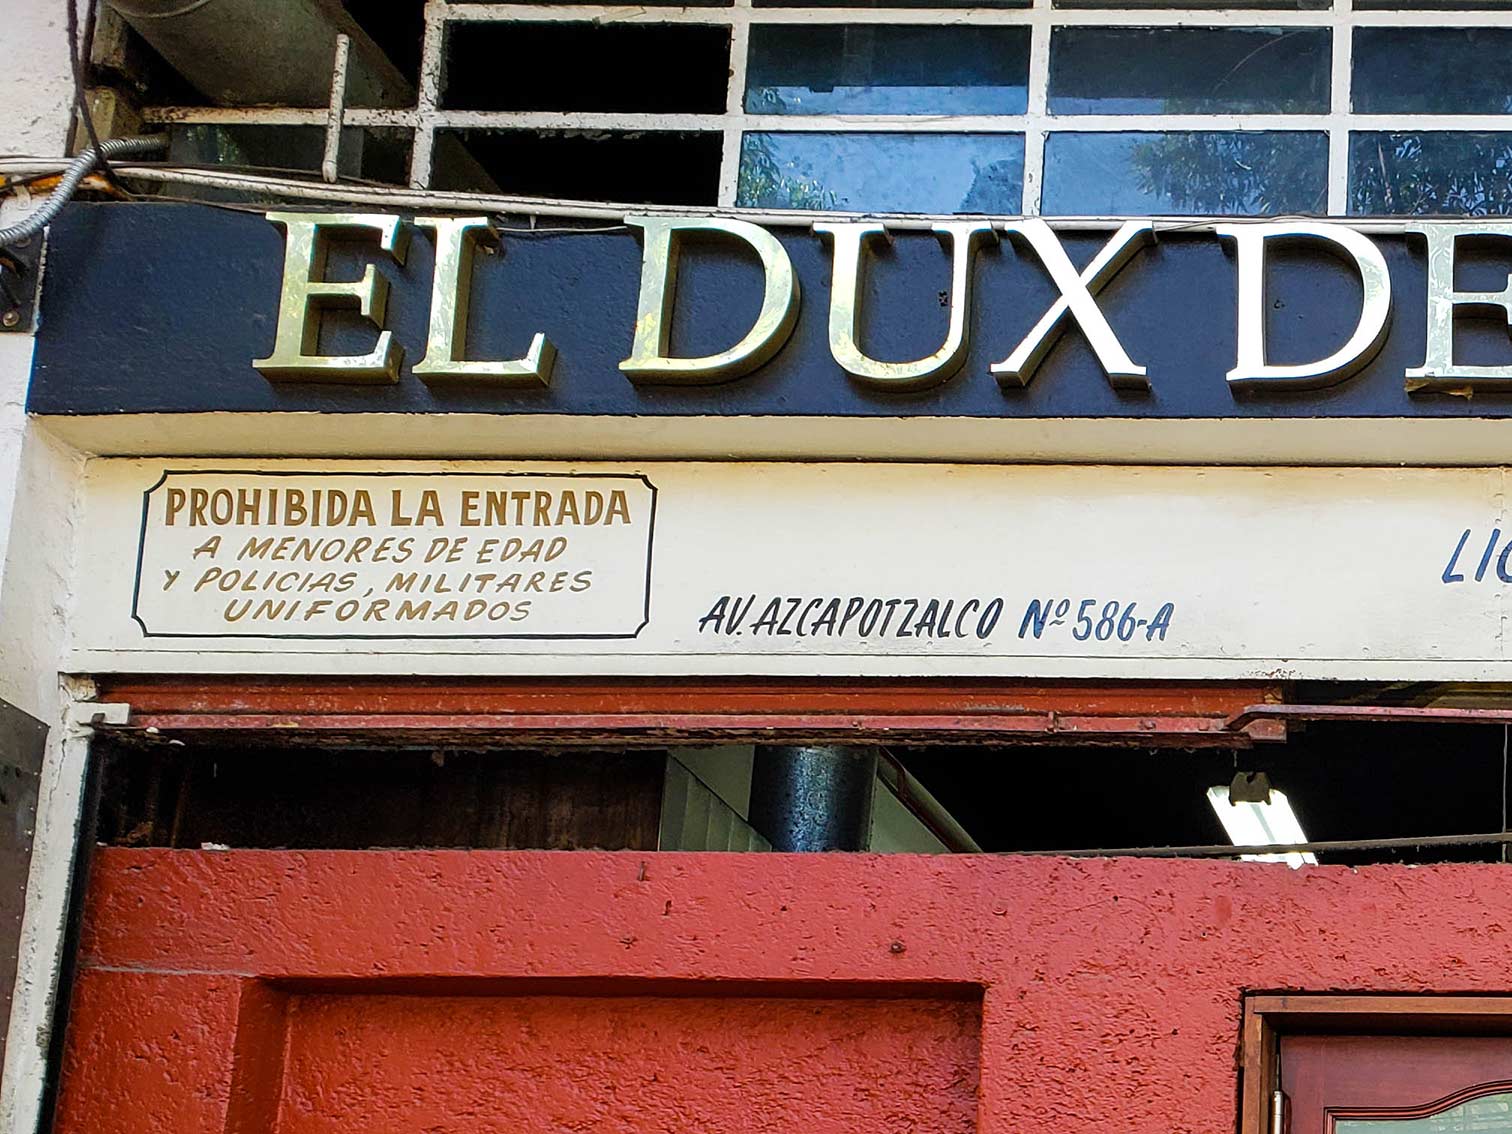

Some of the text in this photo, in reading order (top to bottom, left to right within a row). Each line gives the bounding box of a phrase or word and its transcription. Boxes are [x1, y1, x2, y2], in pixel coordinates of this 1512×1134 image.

[252, 210, 558, 387] EL
[618, 216, 1158, 390] DUX
[165, 487, 632, 527] PROHIBIDA LA ENTRADA
[193, 535, 568, 565] A MENORES DE EDAD
[164, 569, 180, 592] Y
[385, 570, 593, 595] MILITARES
[223, 598, 533, 623] UNIFORMADOS
[752, 596, 1004, 639] AZCAPOTZALCO
[1072, 599, 1176, 642] 586-A
